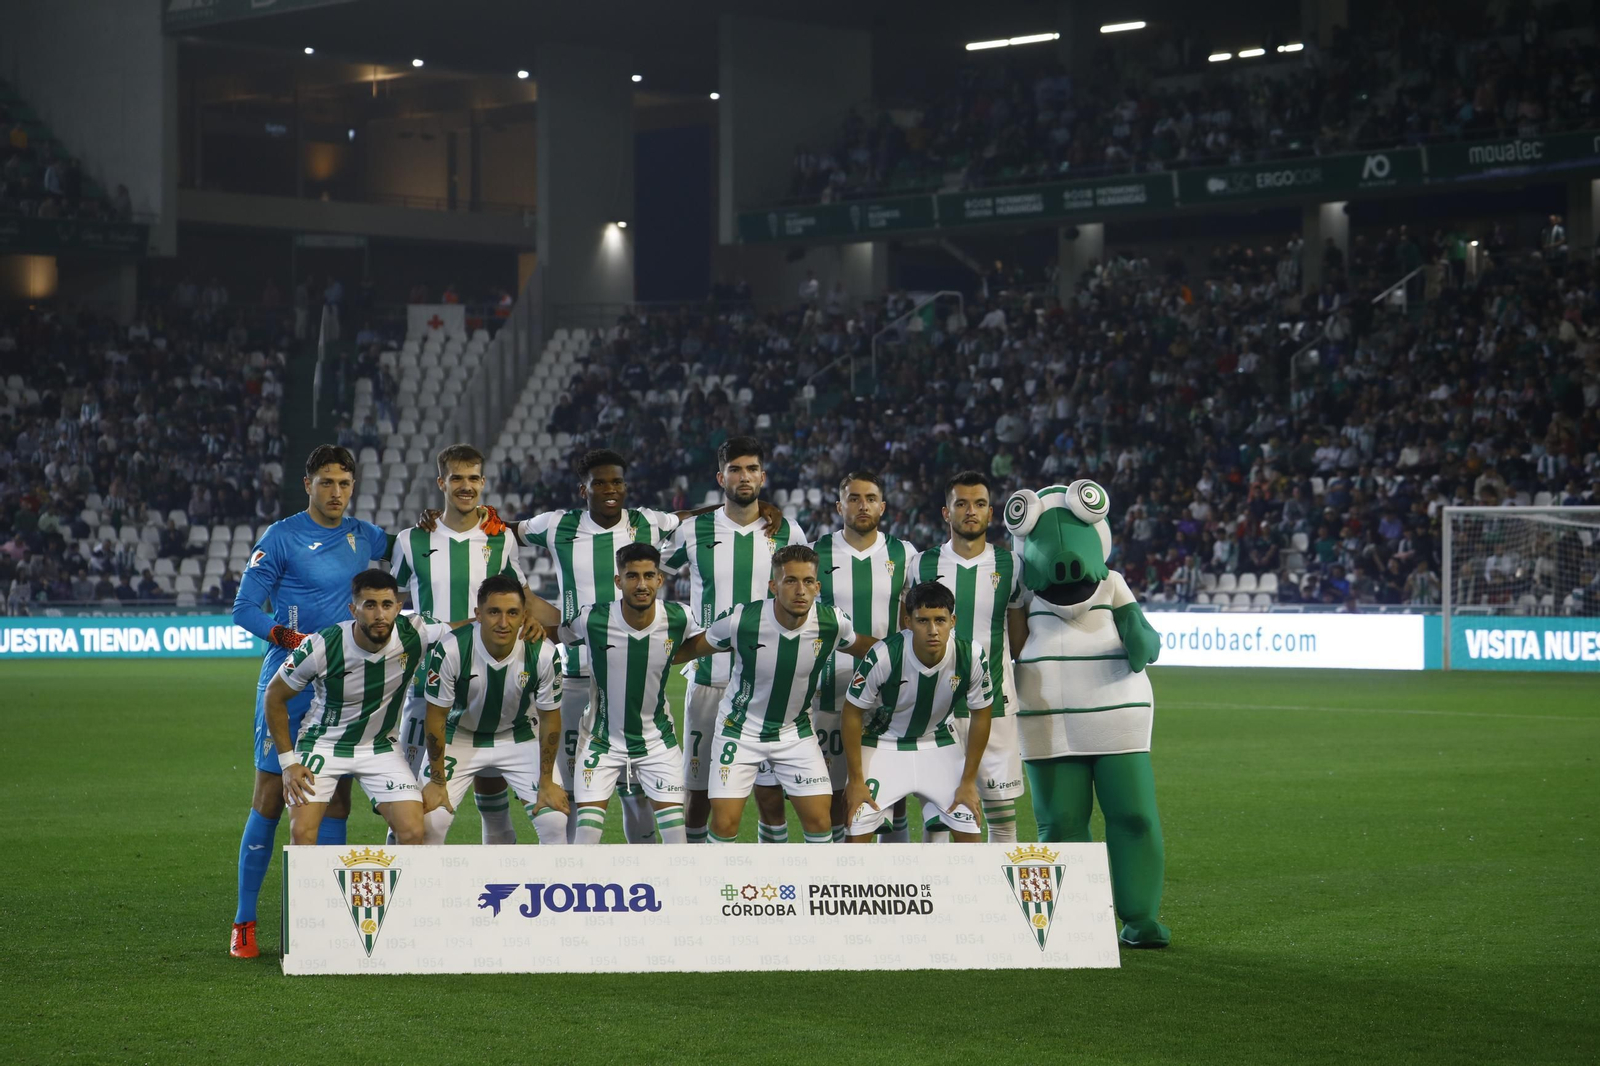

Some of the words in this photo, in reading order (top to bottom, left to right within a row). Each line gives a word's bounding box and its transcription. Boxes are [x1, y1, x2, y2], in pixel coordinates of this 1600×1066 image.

[80, 627, 160, 652] TIENDA
[163, 625, 253, 651] ONLINE:
[1465, 629, 1541, 660] VISITA
[409, 717, 425, 746] 11
[565, 729, 579, 756] 5
[690, 730, 703, 757] 7
[817, 728, 844, 756] 20
[583, 750, 600, 769] 3
[719, 741, 738, 765] 8
[300, 752, 325, 775] 10
[441, 857, 469, 867] 1954
[499, 858, 526, 867] 1954
[555, 858, 584, 868] 1954
[612, 857, 640, 866] 1954
[668, 857, 696, 866] 1954
[724, 856, 752, 866] 1954
[781, 857, 808, 866] 1954
[836, 856, 865, 866] 1954
[891, 856, 919, 865] 1954
[947, 856, 974, 865] 1954
[1061, 855, 1084, 864] 954
[298, 879, 325, 888] 1954
[413, 878, 441, 888] 1954
[699, 876, 725, 886] 1954
[754, 876, 782, 885] 1954
[978, 875, 1004, 885] 1954
[920, 883, 932, 891] DE
[808, 883, 919, 899] PATRIMONIO
[920, 890, 932, 898] LA
[326, 898, 346, 908] 195
[390, 898, 412, 907] 954
[442, 898, 470, 907] 1954
[671, 896, 698, 906] 1954
[952, 894, 978, 904] 1954
[1062, 893, 1088, 902] 1954
[809, 899, 934, 916] HUMANIDAD
[721, 901, 797, 917] CÓRDOBA
[296, 919, 325, 928] 1954
[413, 917, 441, 927] 1954
[471, 917, 499, 926] 1954
[529, 917, 555, 926] 1954
[585, 916, 614, 926] 1954
[643, 916, 670, 925] 1954
[699, 916, 727, 925] 1954
[756, 916, 783, 924] 1954
[813, 915, 840, 925] 1954
[868, 915, 896, 924] 1954
[924, 914, 951, 923] 1954
[979, 913, 1007, 923] 1954
[329, 939, 356, 949] 1954
[386, 938, 415, 949] 1954
[445, 938, 473, 947] 1954
[502, 937, 531, 947] 1954
[560, 937, 588, 946] 1954
[618, 937, 644, 946] 1954
[674, 936, 703, 946] 1954
[731, 936, 759, 945] 1954
[788, 936, 815, 945] 1954
[844, 935, 872, 944] 1954
[900, 934, 927, 944] 1954
[955, 934, 984, 944] 1954
[1012, 933, 1035, 943] 195
[1067, 933, 1094, 942] 1954
[299, 960, 327, 969] 1954
[357, 958, 386, 968] 1954
[417, 958, 444, 967] 1954
[473, 958, 503, 967] 1954
[532, 957, 560, 966] 1954
[590, 956, 617, 965] 1954
[646, 956, 675, 965] 1954
[705, 955, 731, 965] 1954
[760, 955, 789, 965] 1954
[818, 955, 846, 964] 1954
[873, 954, 901, 964] 1954
[929, 954, 957, 963] 1954
[986, 953, 1013, 963] 1954
[1041, 953, 1069, 962] 1954
